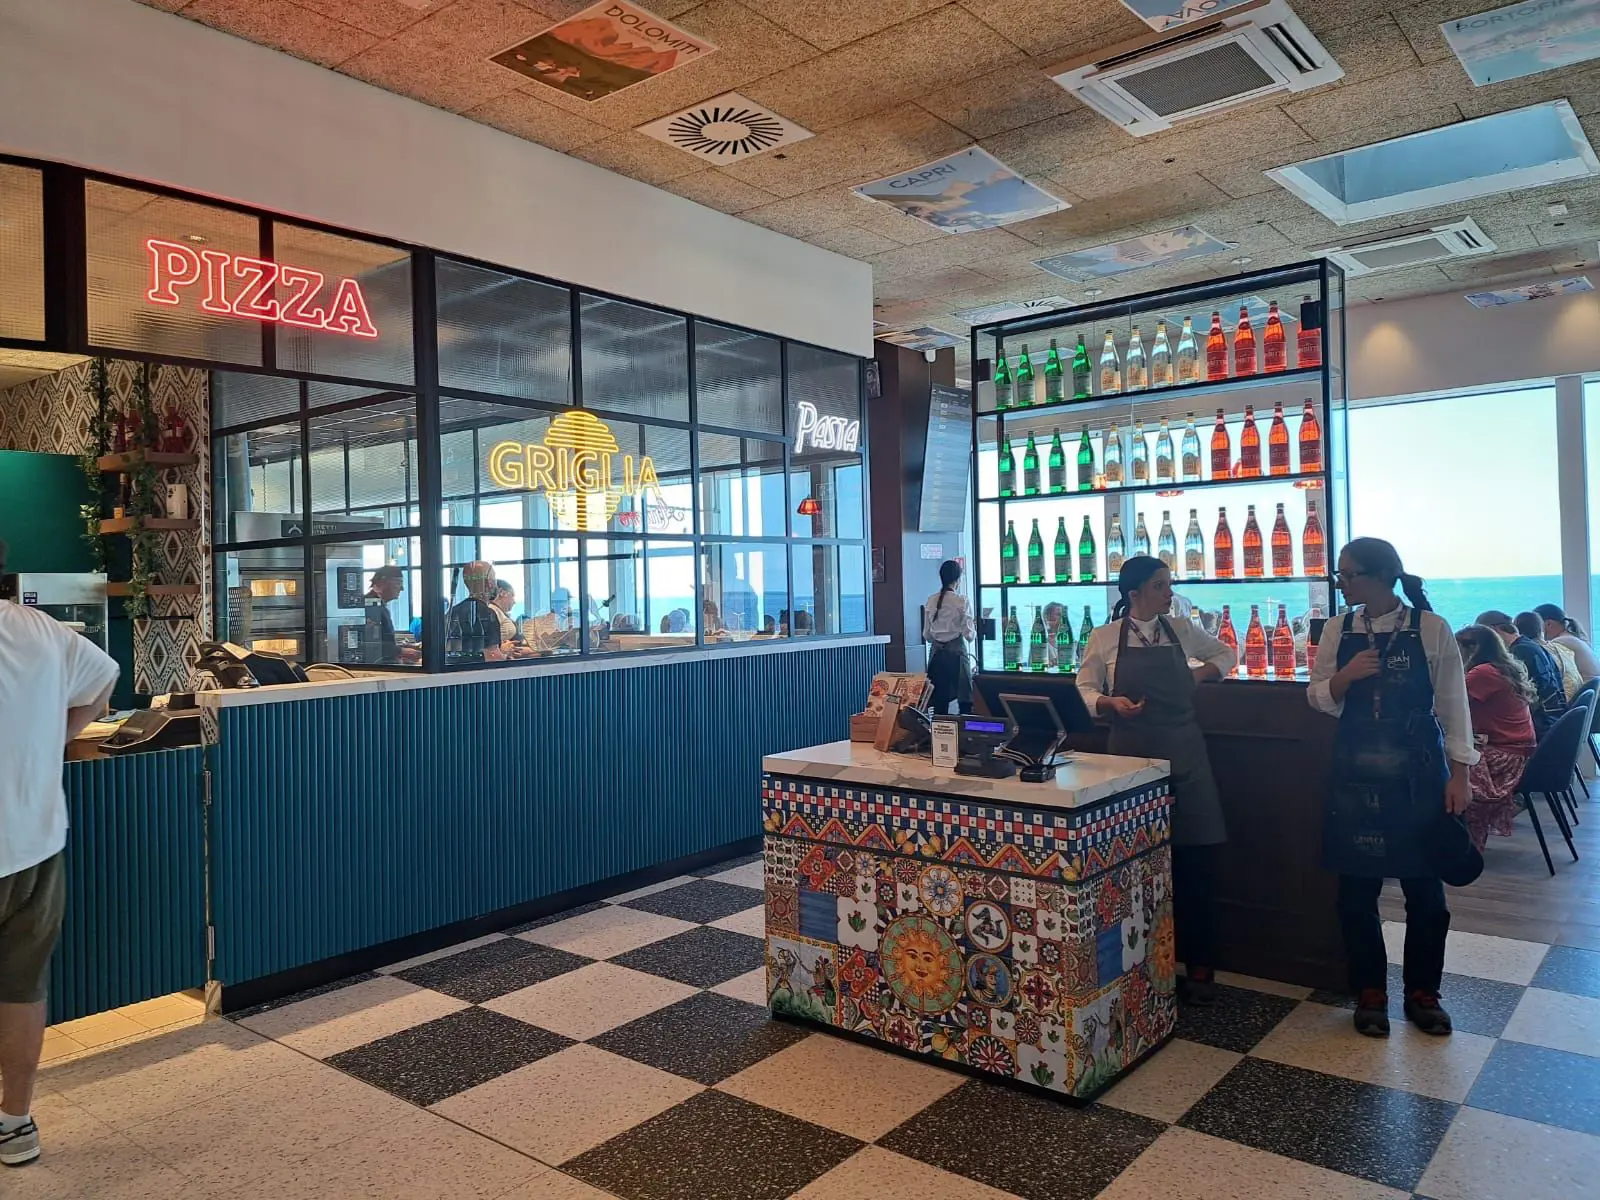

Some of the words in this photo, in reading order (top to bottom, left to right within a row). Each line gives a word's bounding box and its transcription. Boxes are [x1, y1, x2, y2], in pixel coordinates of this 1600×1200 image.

[1456, 0, 1575, 32] PORTOFI
[888, 163, 957, 189] CAPRI
[146, 239, 378, 337] PIZZA
[489, 441, 663, 497] GRIGLIA
